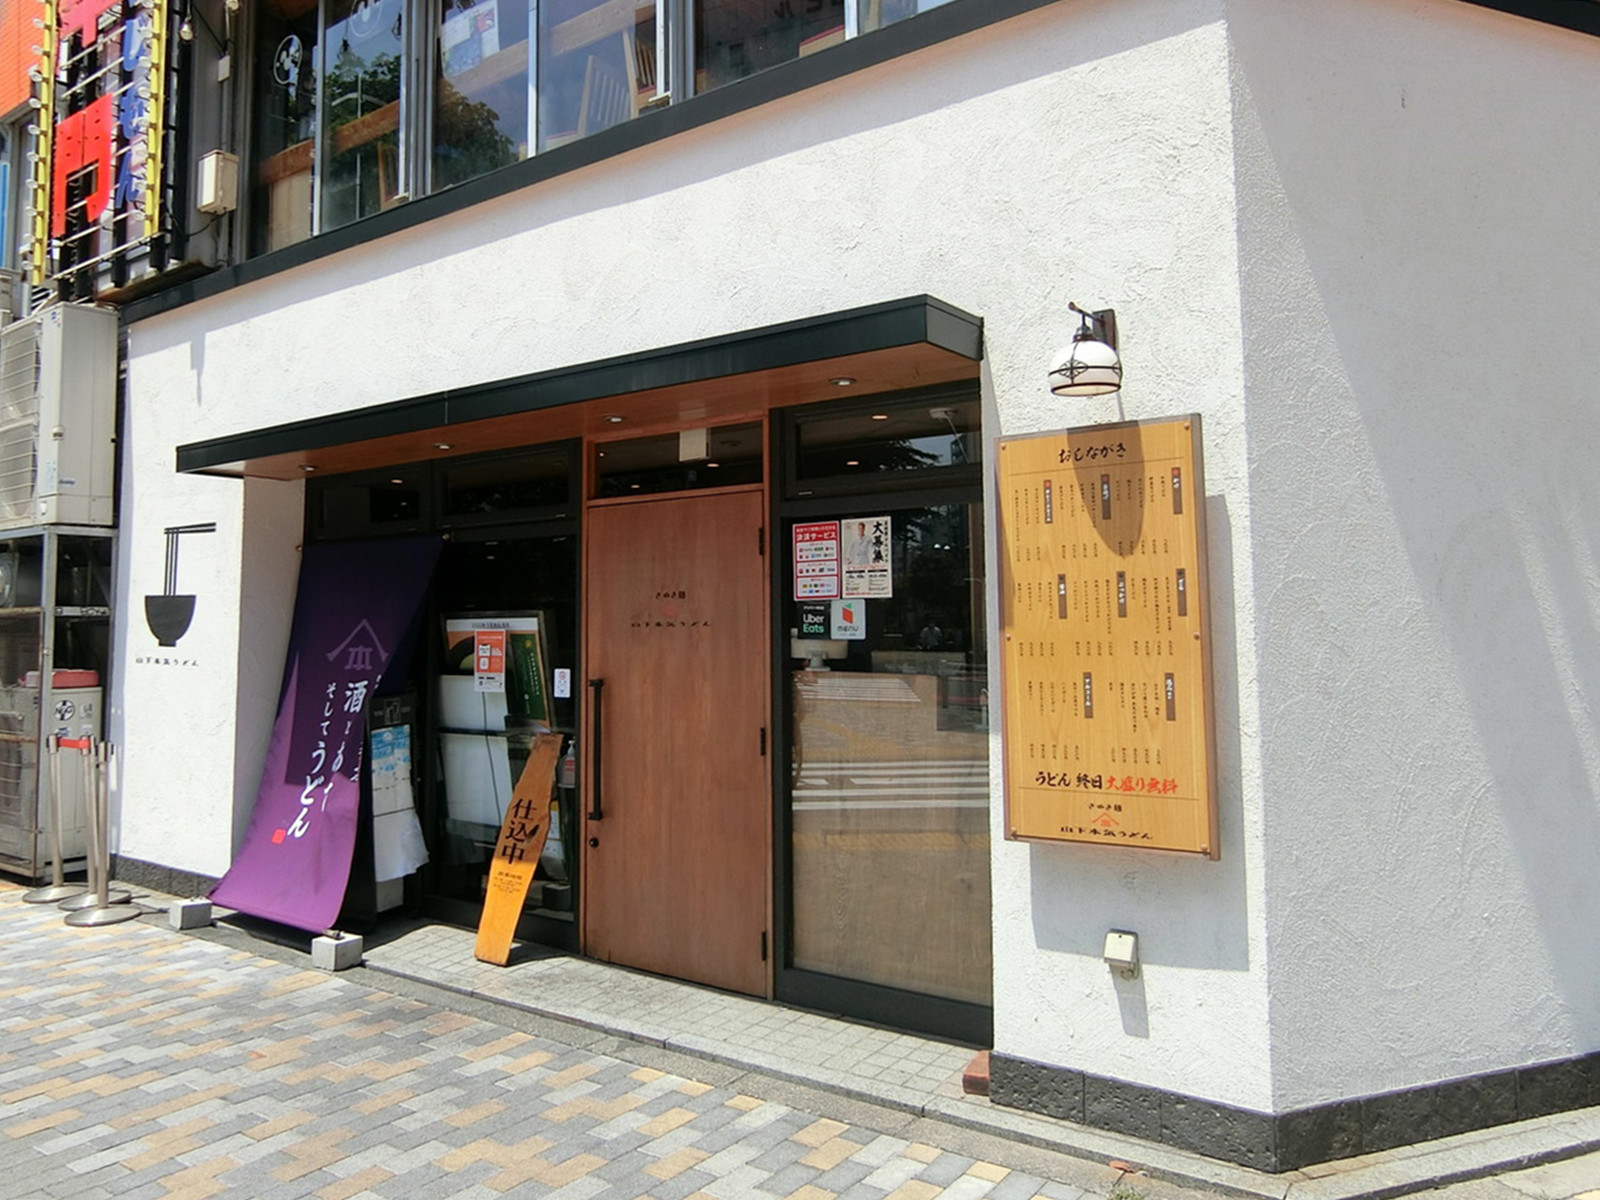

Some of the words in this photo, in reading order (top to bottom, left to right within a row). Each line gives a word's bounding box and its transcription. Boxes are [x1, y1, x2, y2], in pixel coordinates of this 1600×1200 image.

[1057, 441, 1127, 465] おしながき
[872, 520, 884, 562] 大募集
[803, 613, 825, 623] Uber
[803, 623, 825, 634] Eats
[287, 681, 337, 838] そしてうどん
[1035, 771, 1071, 788] うどん
[1075, 772, 1103, 790] 終日
[1106, 775, 1178, 795] 大盛り無料
[501, 797, 537, 865] 仕込中
